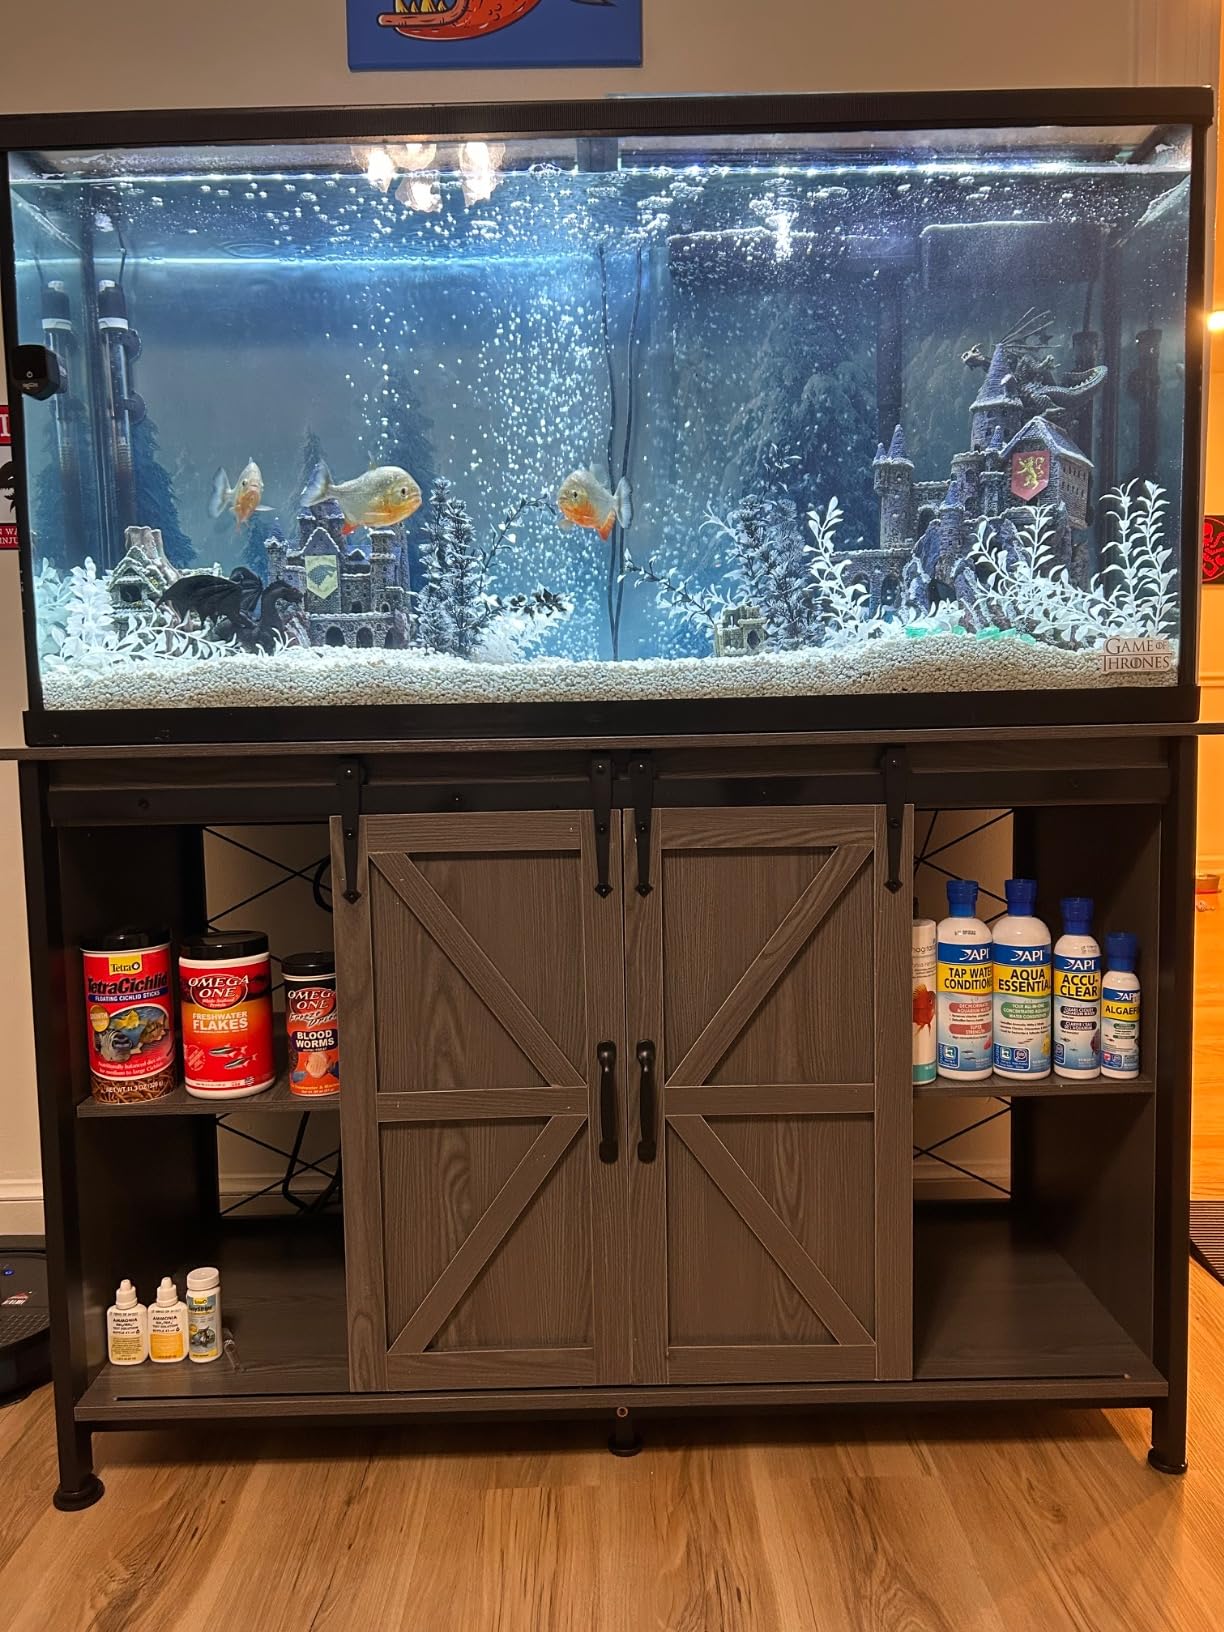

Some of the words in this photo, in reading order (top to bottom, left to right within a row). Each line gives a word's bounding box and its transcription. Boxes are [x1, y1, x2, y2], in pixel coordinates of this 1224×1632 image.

[1105, 637, 1154, 655] GAME
[1155, 641, 1167, 650] OF
[1099, 654, 1170, 672] THRONES
[969, 948, 989, 961] API
[1020, 950, 1043, 962] API
[110, 963, 132, 972] Tetra
[1072, 960, 1095, 971] API
[949, 967, 967, 978] TAP
[1010, 969, 1046, 981] AQUA
[88, 973, 168, 994] TetraCichlid
[188, 974, 249, 987] OMEGA
[1062, 974, 1099, 986] ACCU-
[119, 993, 142, 1001] CICHLID
[143, 990, 160, 999] STICKS
[199, 987, 237, 998] ONE
[1060, 984, 1098, 998] CLEAR
[296, 999, 329, 1010] ONE
[192, 1011, 248, 1021] FRESHWATER
[193, 1018, 249, 1031] FLAKES
[296, 1030, 332, 1040] BLOOD
[295, 1037, 335, 1048] WORMS
